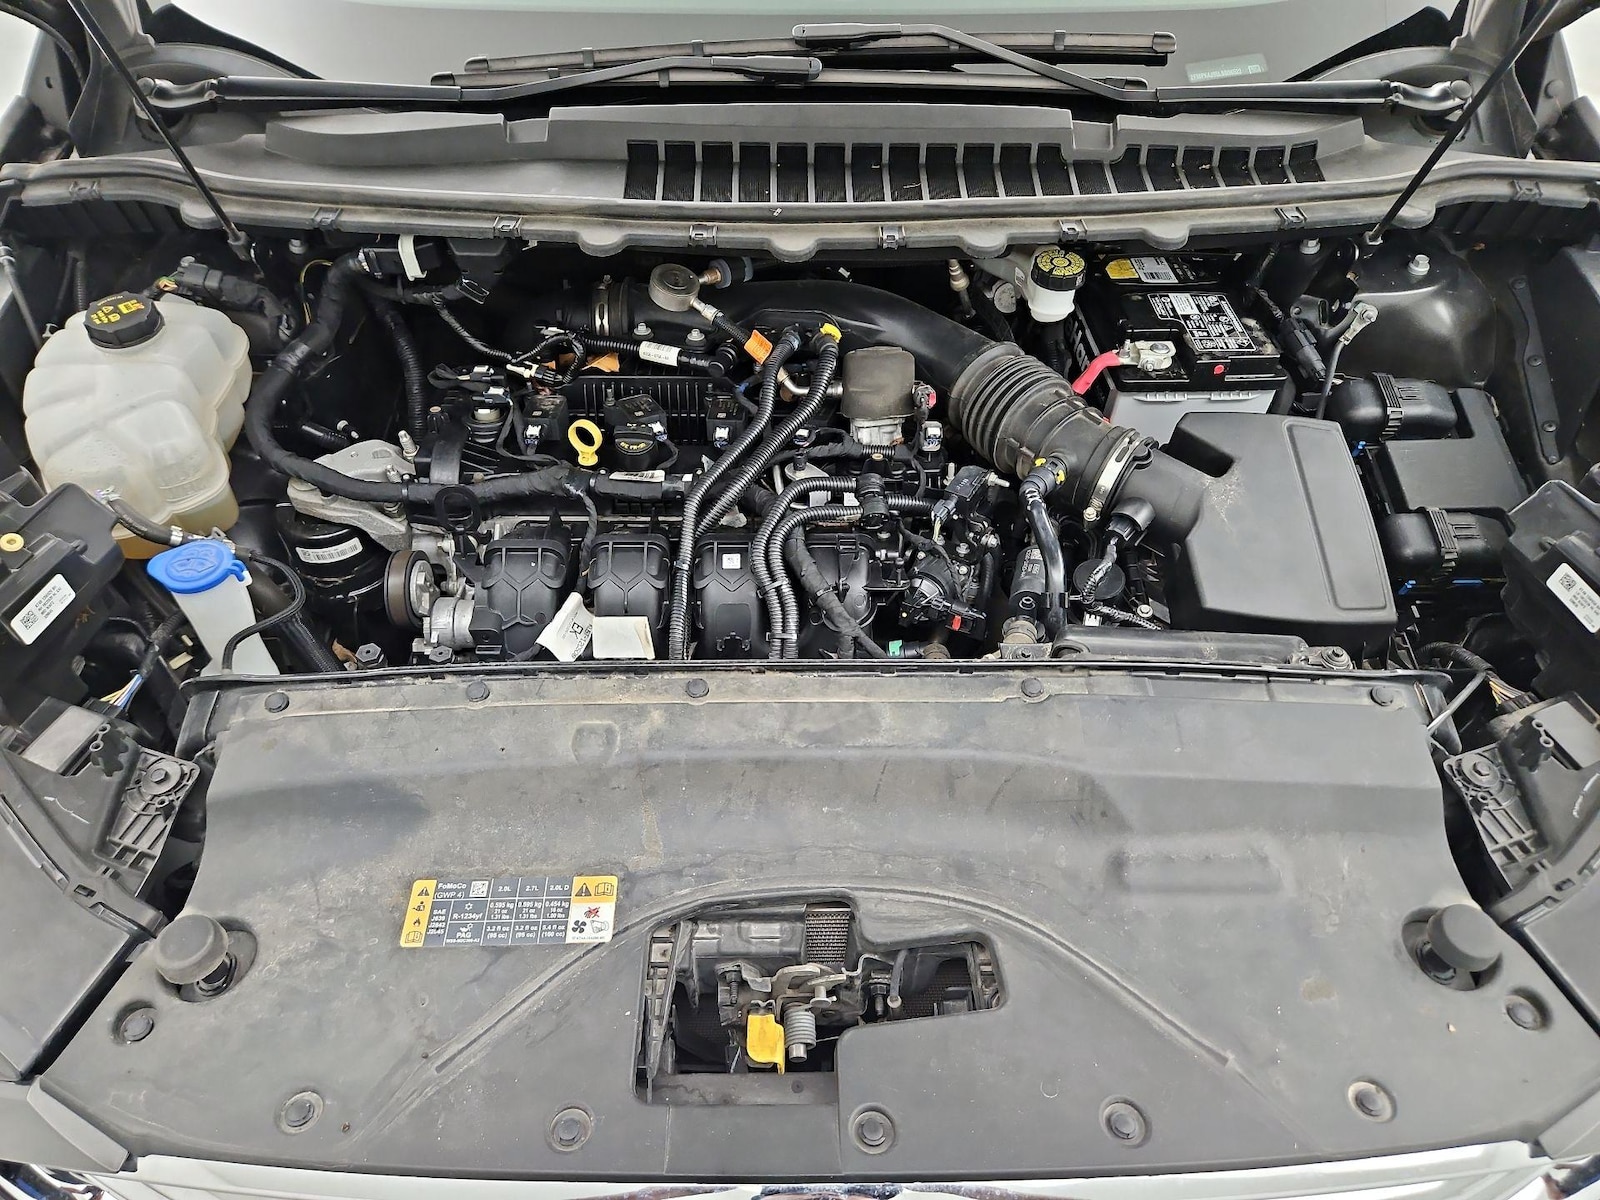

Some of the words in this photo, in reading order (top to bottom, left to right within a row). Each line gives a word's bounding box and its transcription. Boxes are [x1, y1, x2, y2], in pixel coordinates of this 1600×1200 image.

[569, 622, 584, 639] EK
[435, 891, 456, 899] (GWP
[456, 891, 465, 899] 4)
[506, 902, 515, 910] kg
[534, 901, 543, 909] kg
[561, 900, 570, 908] kg
